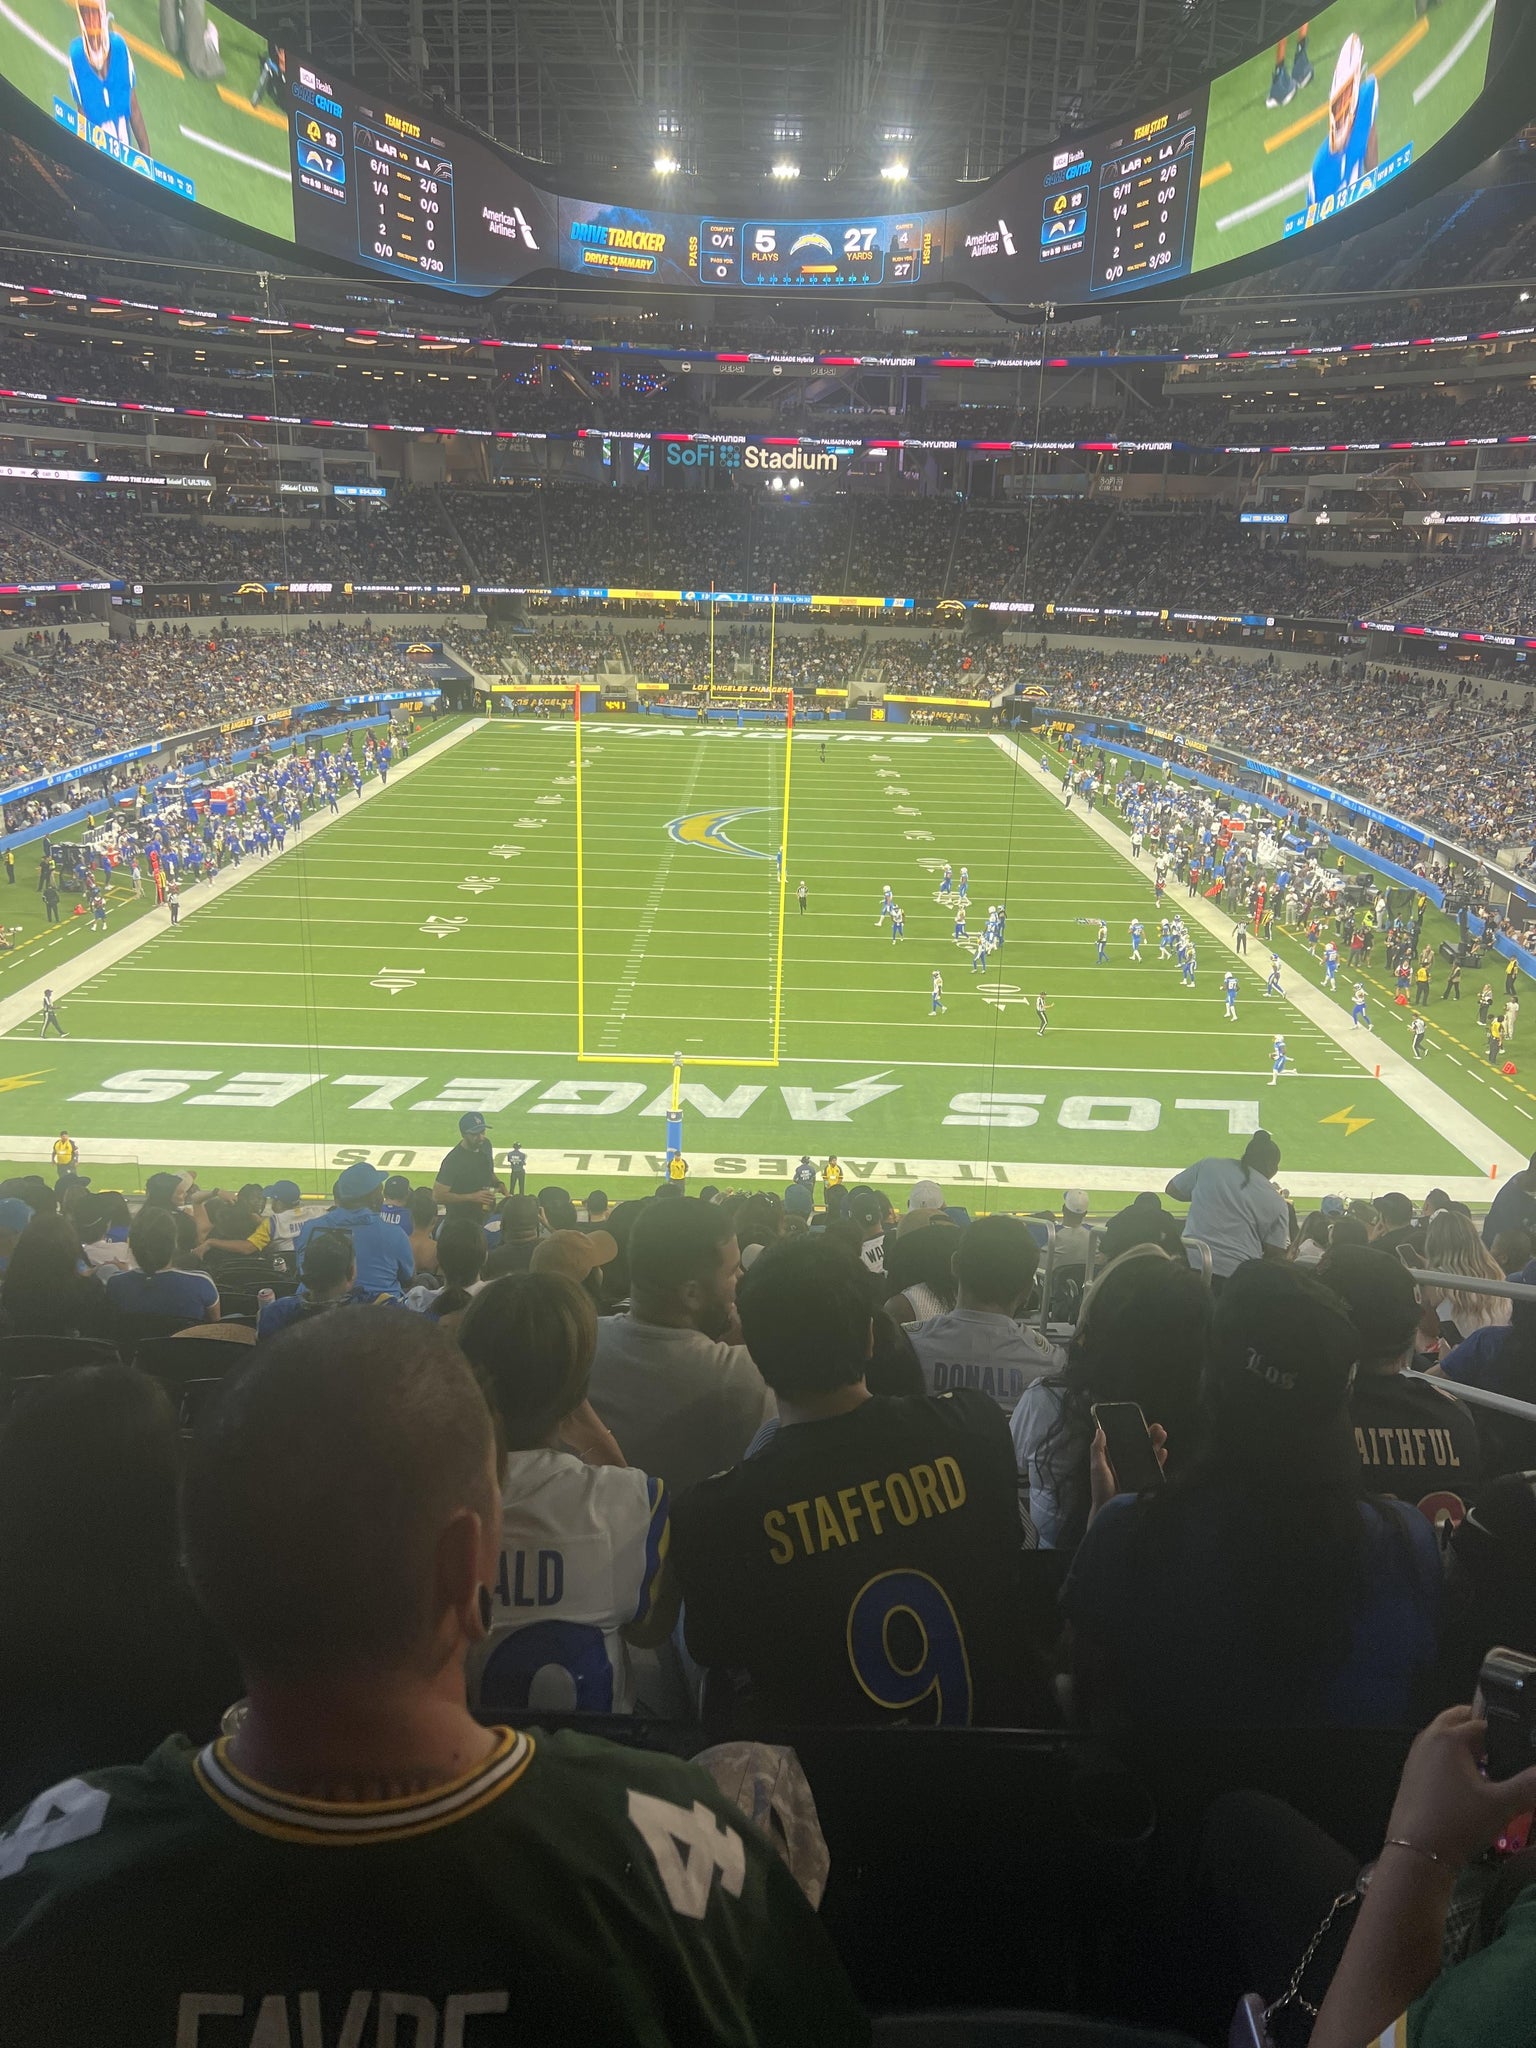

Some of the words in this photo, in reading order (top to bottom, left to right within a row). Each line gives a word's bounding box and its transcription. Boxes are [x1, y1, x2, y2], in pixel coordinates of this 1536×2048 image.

[315, 78, 333, 96] Health
[315, 94, 343, 119] CENTER
[384, 112, 402, 130] TEAM
[401, 120, 421, 138] STATS
[1134, 122, 1150, 140] TEAM
[1149, 115, 1169, 134] STATS
[109, 137, 120, 158] 13
[325, 131, 337, 148] 13
[122, 146, 130, 163] 7
[375, 140, 397, 158] LAR
[415, 156, 431, 171] LA
[1068, 149, 1085, 163] Health
[1121, 158, 1142, 175] LAR
[1159, 145, 1173, 160] LA
[325, 158, 333, 172] 7
[370, 159, 389, 176] 6/11
[1065, 159, 1093, 181] CENTER
[1160, 164, 1177, 183] 2/6
[373, 181, 389, 196] 1/4
[420, 178, 438, 194] 2/6
[1113, 182, 1132, 200] 6/11
[1350, 183, 1357, 203] 7
[1158, 186, 1175, 205] 0/0
[1336, 189, 1348, 209] 13
[379, 203, 385, 215] 1
[420, 198, 439, 214] 0/0
[1113, 204, 1128, 221] 1/4
[482, 206, 516, 226] American
[1160, 210, 1168, 223] 0
[379, 223, 386, 236] 2
[426, 220, 434, 232] 0
[489, 220, 517, 239] Airlines
[1068, 218, 1076, 232] 7
[1116, 226, 1121, 238] 1
[427, 239, 435, 251] 0
[571, 222, 609, 245] DRIVE
[607, 227, 666, 252] TRACKER
[711, 234, 734, 248] 0/1
[755, 229, 776, 253] 5
[844, 227, 877, 252] 27
[899, 232, 908, 244] 4
[965, 231, 999, 247] American
[1158, 232, 1166, 245] 0
[374, 241, 393, 257] 0/0
[688, 236, 698, 267] PASS
[751, 252, 779, 262] PLAYS
[846, 252, 873, 261] YARDS
[922, 233, 932, 265] RUSH
[971, 243, 999, 258] Airlines
[1113, 246, 1120, 259] 2
[420, 256, 444, 272] 3/30
[584, 251, 609, 265] DRIVE
[608, 254, 654, 271] SUMMARY
[1148, 250, 1172, 270] 3/30
[716, 265, 727, 277] 0
[894, 263, 910, 276] 27
[1105, 265, 1123, 281] 0/0
[770, 355, 796, 363] PALISADE
[796, 355, 815, 364] Hybrid
[880, 358, 915, 366] HYUNDAI
[1023, 359, 1041, 367] Hybrid
[719, 365, 746, 373] PEPSI
[810, 367, 836, 376] PEPSI
[634, 431, 651, 440] Hybrid
[711, 435, 746, 443] HYUNDAI
[847, 439, 862, 447] Hybrid
[922, 441, 957, 449] HYUNDAI
[1057, 442, 1075, 450] Hybrid
[1137, 442, 1172, 450] HYUNDAI
[666, 443, 715, 467] SoFi
[744, 445, 838, 471] Stadium
[106, 475, 129, 483] AROUND
[141, 477, 165, 485] LEAGUE
[188, 479, 211, 487] ULTRA
[302, 485, 319, 493] ULTRA
[1446, 515, 1469, 523] AROUND
[289, 583, 308, 592] HOME
[308, 583, 333, 592] OPENER
[989, 602, 1009, 610] HOME
[1009, 602, 1035, 612] OPENER
[710, 684, 748, 692] ANGELES
[414, 701, 423, 711] UP
[605, 701, 626, 710] 4:41
[220, 723, 230, 733] LOS
[230, 717, 254, 731] ANGELES
[1066, 723, 1076, 732] UP
[541, 724, 933, 744] CHARGERS
[1145, 727, 1154, 735] LOS
[1153, 729, 1174, 741] ANGELES
[1184, 739, 1209, 752] CHARGERS
[488, 843, 527, 857] 40
[457, 874, 501, 891] 30
[419, 914, 469, 934] 20
[369, 965, 427, 989] 10
[976, 983, 1030, 1006] 10
[65, 1068, 905, 1123] ANGELES
[941, 1091, 1261, 1136] LOS
[331, 1148, 417, 1167] US
[563, 1152, 670, 1173] ALL
[953, 1163, 1010, 1184] IT
[379, 1212, 401, 1225] NALD
[1244, 1347, 1296, 1391] Los
[933, 1361, 1024, 1398] DONALD
[1354, 1426, 1460, 1467] AITHFUL
[763, 1456, 968, 1566] STAFFORD
[494, 1549, 565, 1608] ALD
[846, 1567, 973, 1727] 9
[627, 1787, 747, 1921] 4
